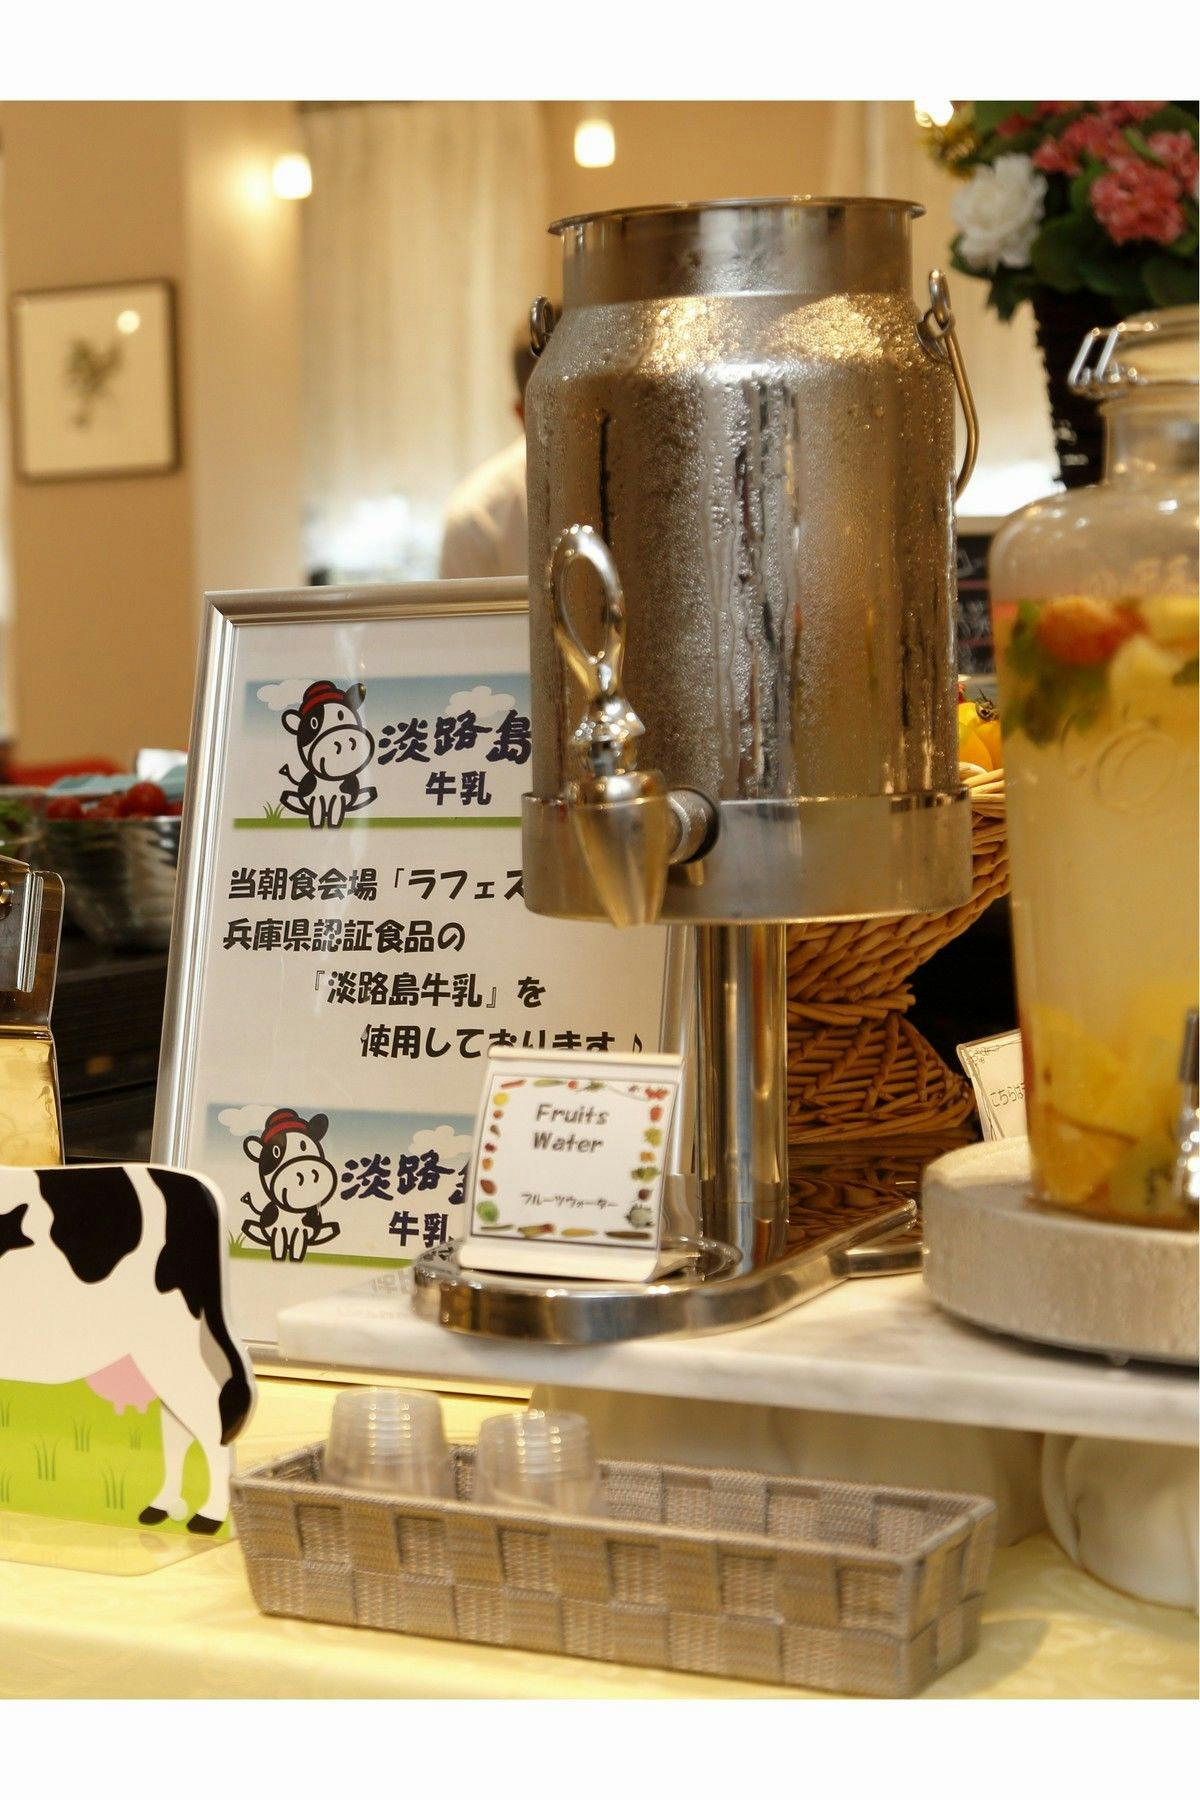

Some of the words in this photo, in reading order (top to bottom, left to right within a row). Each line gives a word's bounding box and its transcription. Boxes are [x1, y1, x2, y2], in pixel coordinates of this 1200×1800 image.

[378, 709, 532, 765] 淡路島
[425, 770, 492, 806] 牛乳
[222, 917, 466, 953] 兵庫県認証食品の
[314, 969, 547, 1009] 『淡路島牛乳』を
[536, 1103, 610, 1125] Fruits
[532, 1132, 604, 1153] Water
[521, 1192, 619, 1208] フルーツウォーター
[388, 1210, 454, 1248] 牛乳
